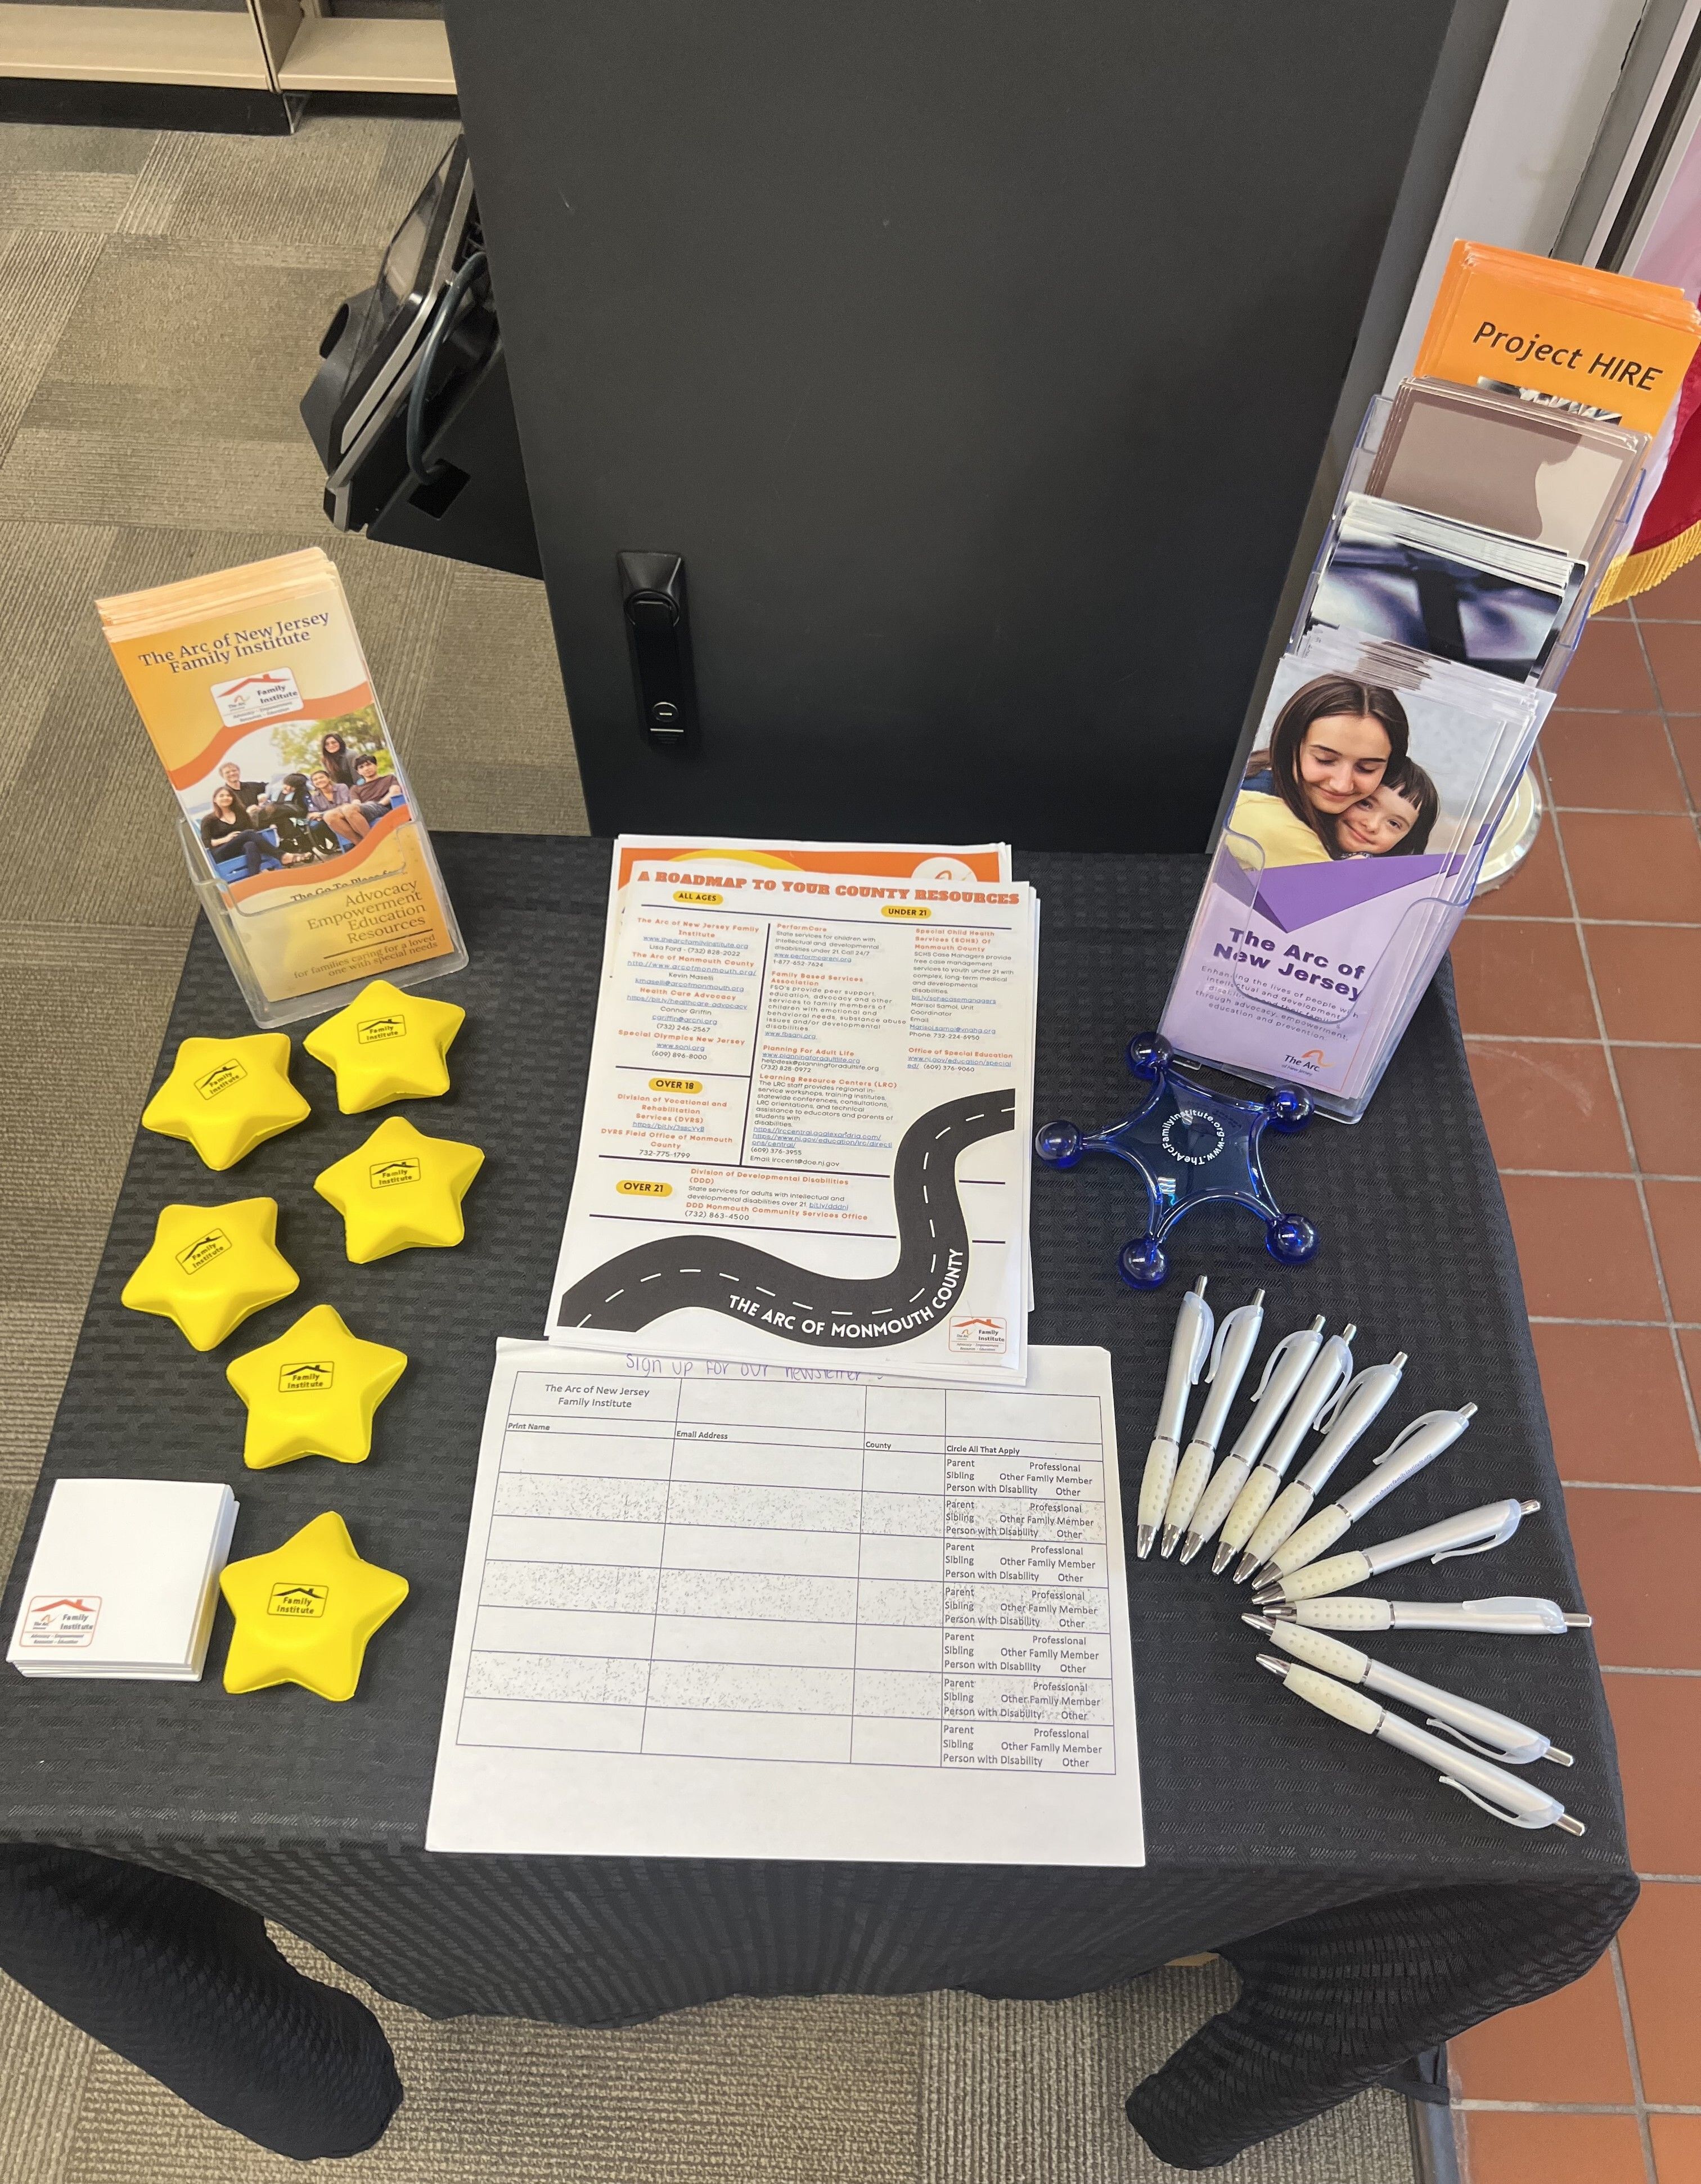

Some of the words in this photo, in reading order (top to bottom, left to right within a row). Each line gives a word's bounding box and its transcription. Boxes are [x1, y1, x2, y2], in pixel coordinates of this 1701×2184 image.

[1473, 321, 1582, 370] Project
[1588, 353, 1663, 391] HIRE
[138, 650, 173, 667] The
[180, 641, 208, 659] Arc
[213, 634, 232, 649] of
[235, 626, 272, 645] New
[277, 611, 329, 636] Jersey
[169, 651, 231, 674] Family
[235, 628, 310, 658] Institute
[257, 685, 286, 696] Family
[260, 691, 298, 703] Institute
[345, 880, 417, 907] Advocacy
[638, 871, 650, 882] A
[655, 872, 747, 888] ROADMAP
[752, 880, 776, 890] TO
[782, 881, 830, 895] YOUR
[835, 885, 911, 899] COUNTY
[915, 890, 1019, 904] RESOURCES
[307, 891, 422, 930] Empowerment
[348, 904, 426, 931] Education
[346, 916, 425, 943] Resources
[294, 970, 308, 979] for
[311, 960, 349, 974] families
[352, 948, 382, 963] caring
[384, 945, 398, 954] for
[409, 934, 435, 946] loved
[328, 968, 346, 976] one
[349, 960, 371, 971] with
[374, 950, 407, 964] special
[409, 942, 438, 954] needs
[1230, 927, 1275, 952] The
[1284, 944, 1329, 968] Arc
[1338, 965, 1366, 979] of
[1213, 943, 1271, 969] New
[1278, 963, 1363, 1002] Jersey
[1253, 979, 1267, 987] the
[1271, 984, 1291, 995] lives
[1306, 996, 1336, 1010] people
[1196, 990, 1231, 1005] through
[1281, 1014, 1349, 1042] empowerment,
[1208, 1003, 1253, 1019] education
[1257, 1015, 1273, 1024] and
[367, 1032, 398, 1041] Institute
[619, 1029, 651, 1038] Special
[654, 1032, 693, 1041] Olympics
[717, 1037, 745, 1046] Jersey
[673, 1052, 707, 1060] 896-8000
[763, 1045, 798, 1053] Planning
[1284, 1054, 1302, 1066] The
[1305, 1061, 1320, 1071] Arc
[209, 1073, 232, 1087] Family
[209, 1075, 239, 1094] Institute
[656, 1080, 682, 1089] OVER
[639, 1150, 690, 1159] 732-775-1799
[379, 1176, 412, 1185] Institute
[691, 1168, 723, 1177] Division
[737, 1172, 800, 1182] Developmental
[803, 1176, 849, 1186] Disabilities
[623, 1182, 651, 1191] OVER
[654, 1184, 663, 1192] 21
[685, 1210, 706, 1219] (732)
[709, 1212, 749, 1221] 863-4500
[192, 1244, 215, 1260] Family
[192, 1246, 224, 1268] Institute
[730, 1295, 760, 1316] THE
[760, 1309, 796, 1330] ARC
[801, 1319, 826, 1335] OF
[831, 1306, 934, 1338] MONMOUTH
[932, 1248, 963, 1309] COUNTY
[626, 1353, 662, 1377] Sign
[673, 1361, 693, 1376] up
[545, 1384, 562, 1393] The
[565, 1385, 581, 1394] Arc
[583, 1385, 594, 1394] of
[596, 1386, 618, 1395] New
[619, 1388, 650, 1398] Jersey
[559, 1397, 590, 1408] Family
[592, 1399, 632, 1408] Institute
[677, 1430, 696, 1439] Email
[866, 1441, 891, 1451] County
[998, 1447, 1020, 1456] Apply
[1030, 1462, 1081, 1472] Professional
[1027, 1475, 1054, 1483] Family
[1000, 1485, 1038, 1496] Disability
[284, 1597, 312, 1606] Family
[277, 1605, 314, 1614] Institute
[943, 1725, 974, 1734] Parent
[1034, 1728, 1089, 1739] Professional
[943, 1740, 974, 1750] Sibling
[1001, 1742, 1028, 1750] Other
[1031, 1744, 1060, 1754] Family
[1063, 1745, 1102, 1754] Member
[943, 1754, 974, 1763] Person
[978, 1755, 997, 1764] with
[1001, 1756, 1042, 1767] Disability
[1063, 1758, 1089, 1767] Other
